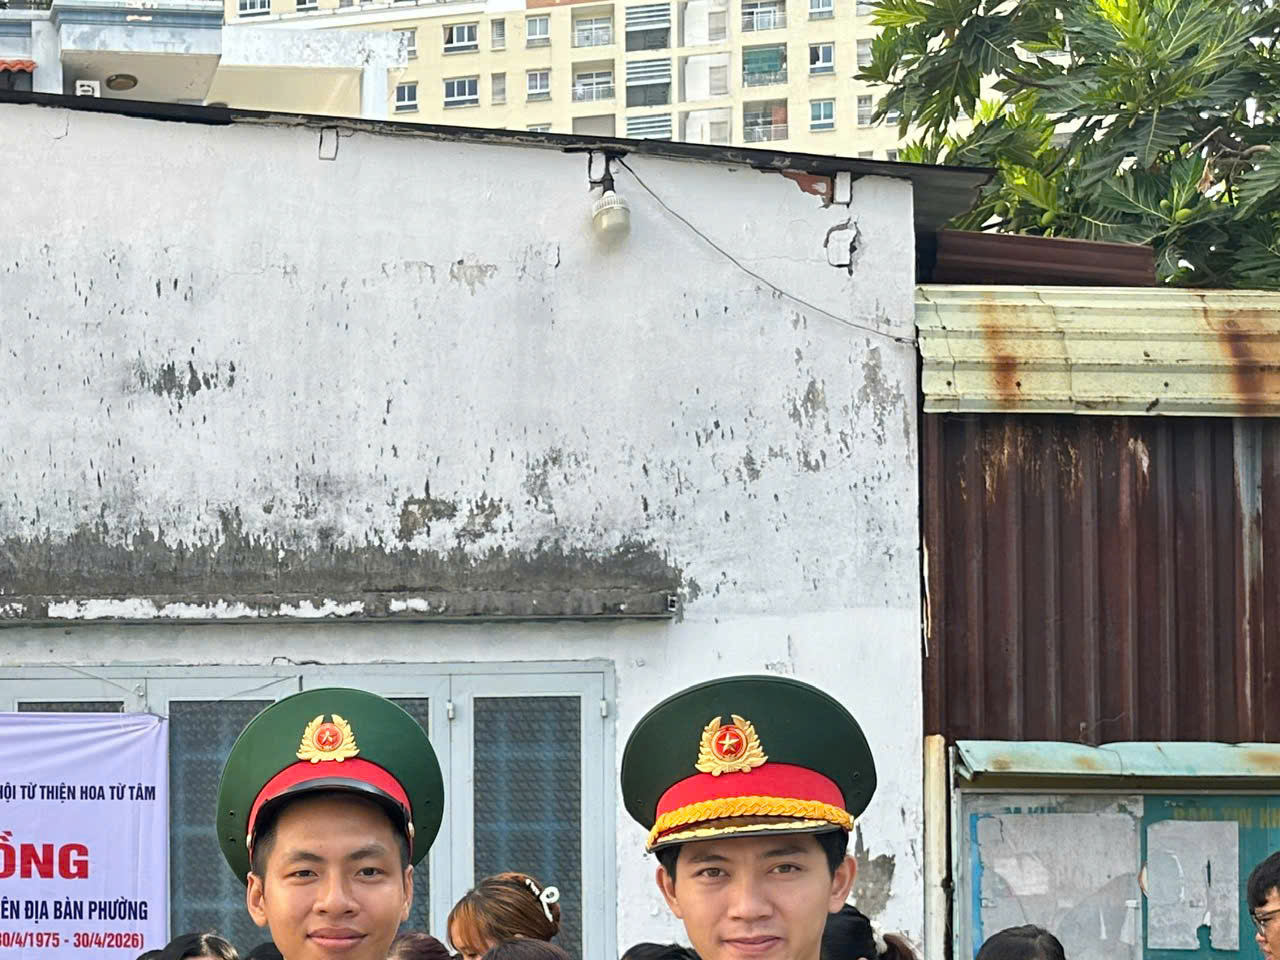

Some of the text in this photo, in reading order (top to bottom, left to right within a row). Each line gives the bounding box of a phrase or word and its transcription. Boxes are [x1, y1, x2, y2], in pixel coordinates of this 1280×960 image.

[20, 782, 37, 800] TỪ
[40, 782, 76, 803] THIỆN
[80, 786, 105, 801] HOA
[109, 783, 126, 801] TỪ
[129, 783, 156, 801] TÂM
[24, 899, 50, 925] ĐỊA
[54, 896, 83, 920] BÀN
[88, 895, 148, 921] PHƯỜNG
[73, 932, 145, 950] 30/4/2026)
